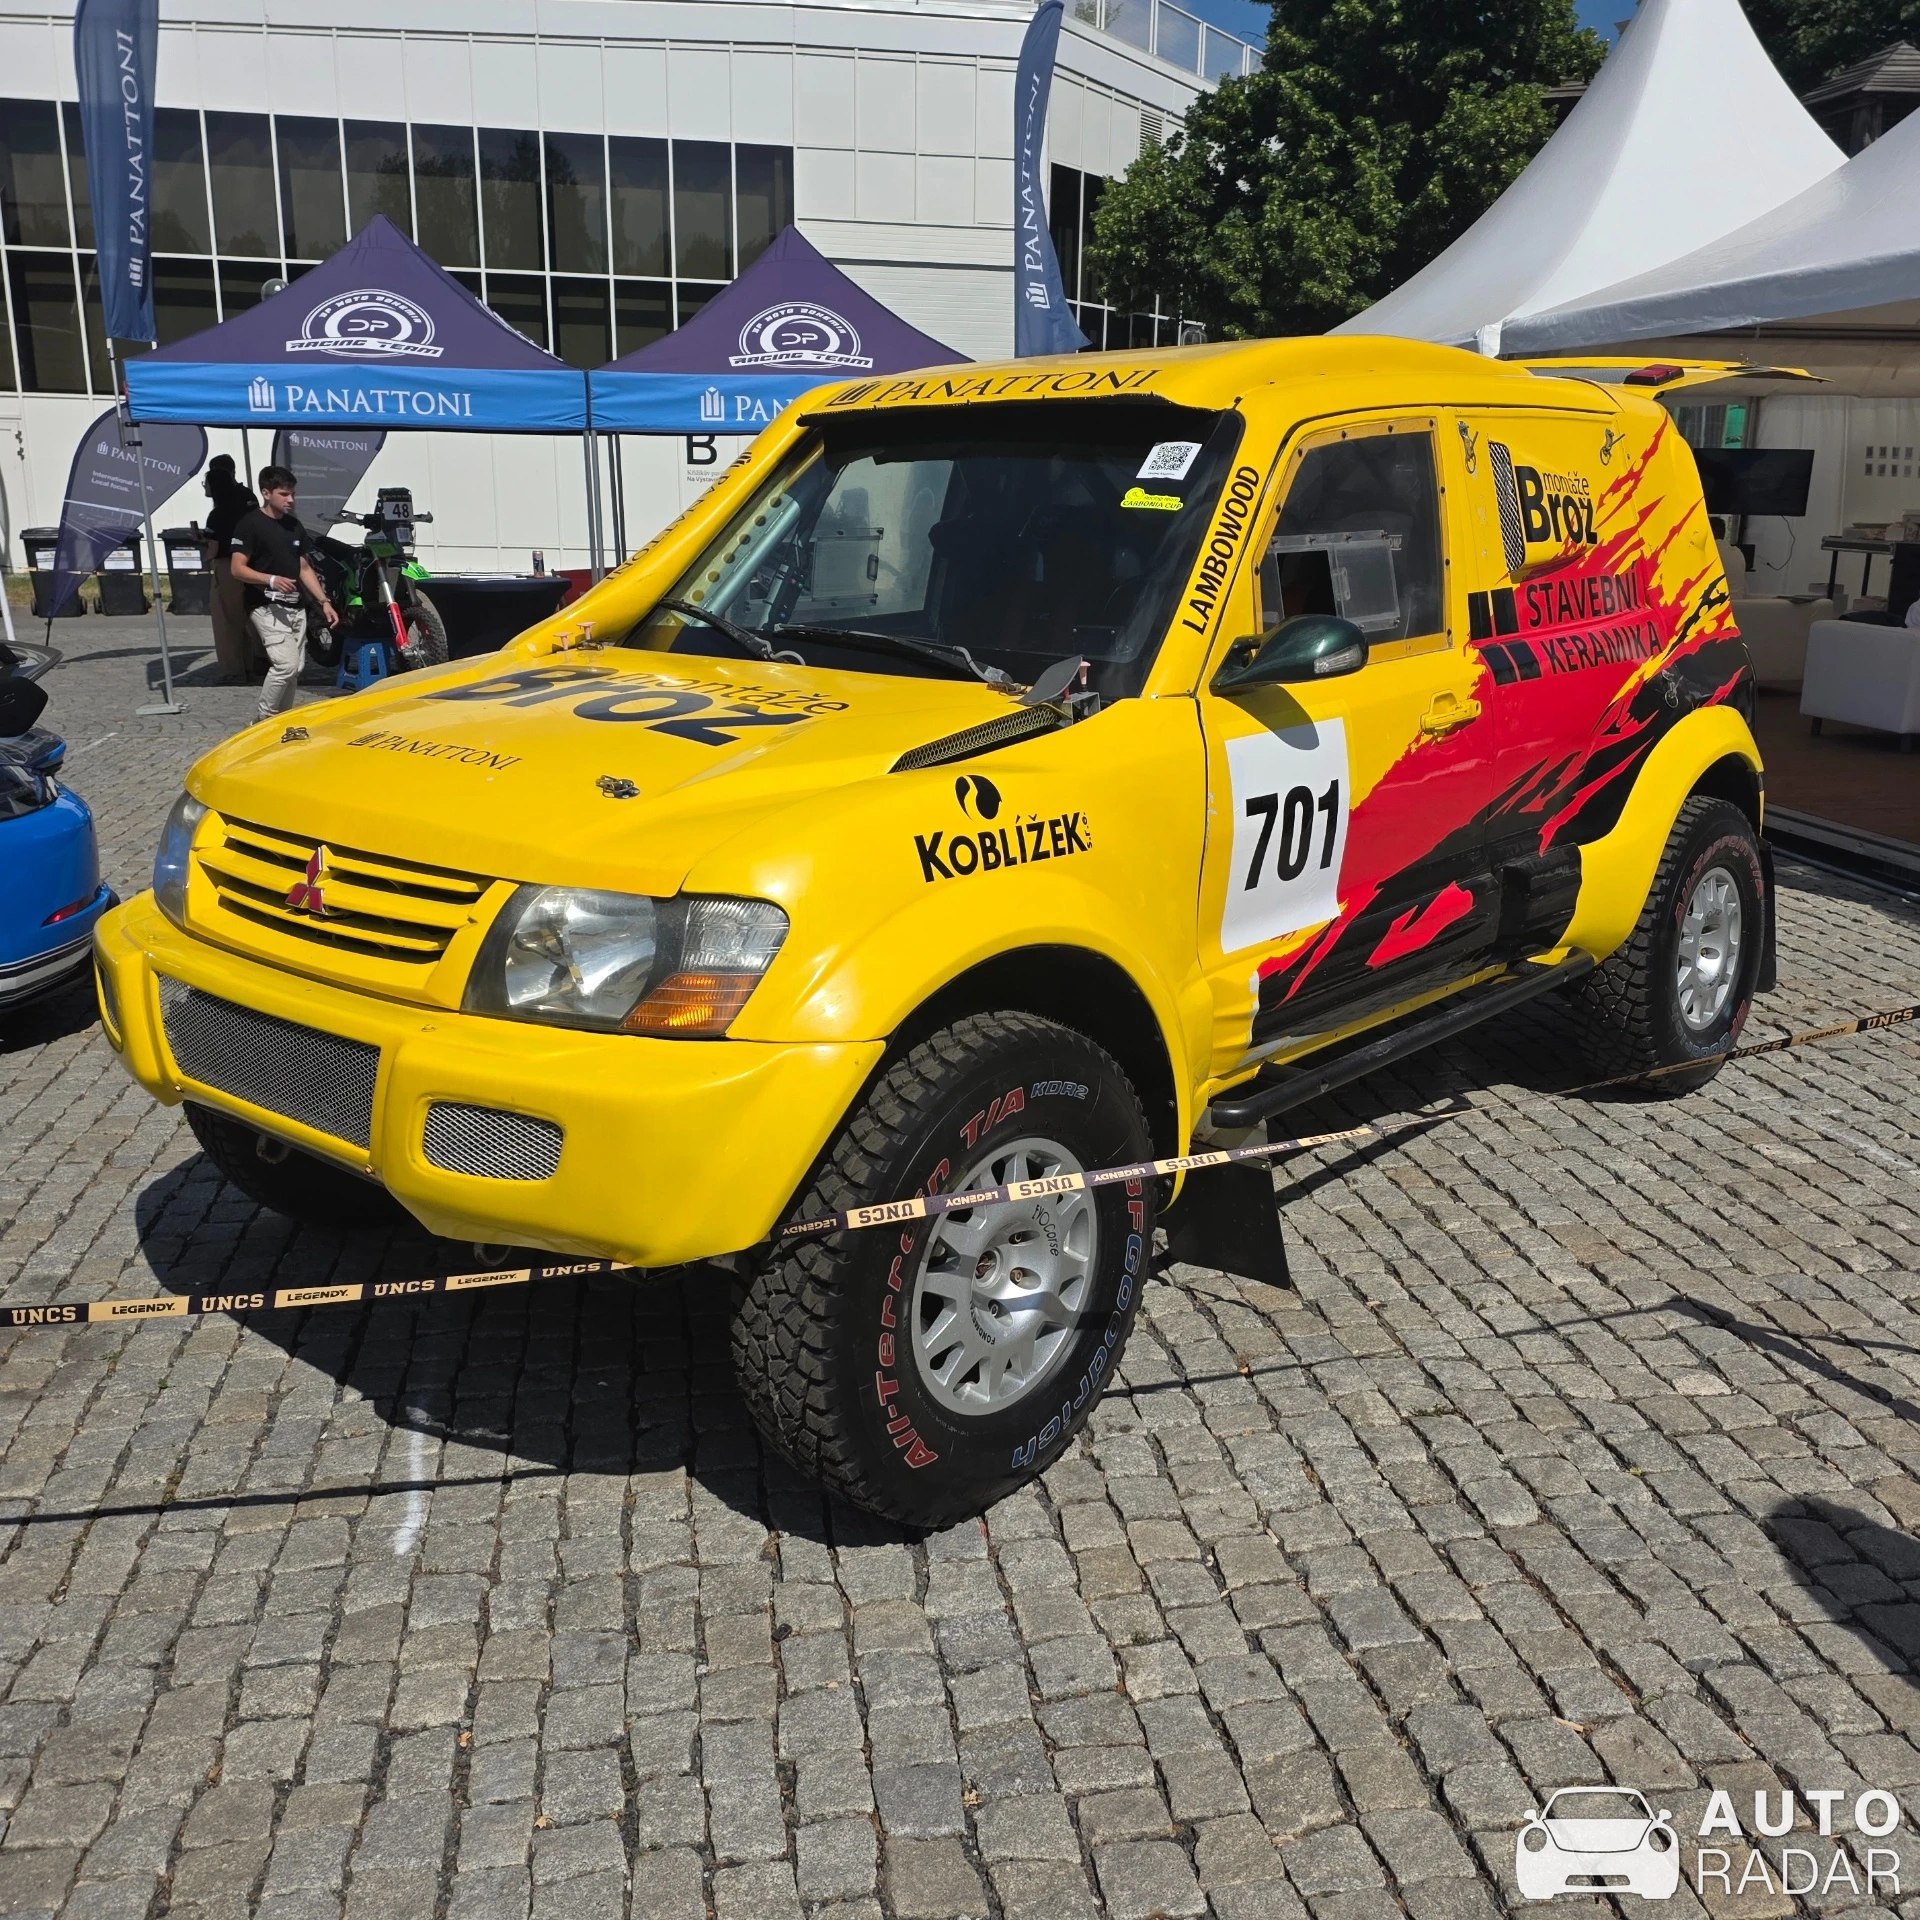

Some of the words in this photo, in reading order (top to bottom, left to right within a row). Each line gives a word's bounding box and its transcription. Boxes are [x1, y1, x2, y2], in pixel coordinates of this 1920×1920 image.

[115, 29, 144, 246] PANATTONI
[1021, 71, 1043, 273] PANATTONI
[336, 295, 370, 308] MOTO
[375, 295, 423, 324] BOHEMIA
[347, 318, 389, 332] DP
[764, 308, 794, 322] MOTO
[800, 308, 847, 335] BOHEMIA
[289, 339, 368, 349] RACING
[376, 340, 440, 355] TEAM
[781, 332, 818, 345] DP
[732, 352, 804, 365] RACING
[811, 353, 871, 366] TEAM
[285, 385, 473, 417] PANATTONI
[871, 369, 1163, 402] PANATTONI
[303, 436, 368, 451] PANATTONI
[686, 435, 717, 465] B
[111, 447, 181, 475] PANTTONI
[1541, 471, 1590, 496] montáže
[392, 503, 410, 518] 48
[1514, 465, 1598, 544] Brož
[1182, 466, 1260, 635] LAMBOWOOD
[1525, 560, 1640, 628] STAVEBNÍ
[1539, 620, 1663, 675] KERAMIKA
[414, 665, 814, 747] Brož
[606, 672, 850, 716] montáže
[368, 735, 523, 771] PANATTONI
[913, 812, 1089, 883] KOBLÍŽEK
[1244, 779, 1340, 892] 701
[1733, 1040, 1783, 1057] UNCS
[1866, 1009, 1914, 1029] UNCS
[1166, 1153, 1220, 1171] UNCS
[1019, 1177, 1074, 1197] UNCS
[859, 1203, 915, 1224] UNCS
[876, 1158, 950, 1470] All-Terran
[959, 1087, 1025, 1149] T/A
[1031, 1080, 1088, 1100] KDR2
[11, 1306, 77, 1325] UNCS
[201, 1294, 265, 1312] UNCS
[373, 1279, 436, 1296] UNCS
[541, 1262, 601, 1277] UNCS
[1012, 1173, 1144, 1470] BFGoodrich
